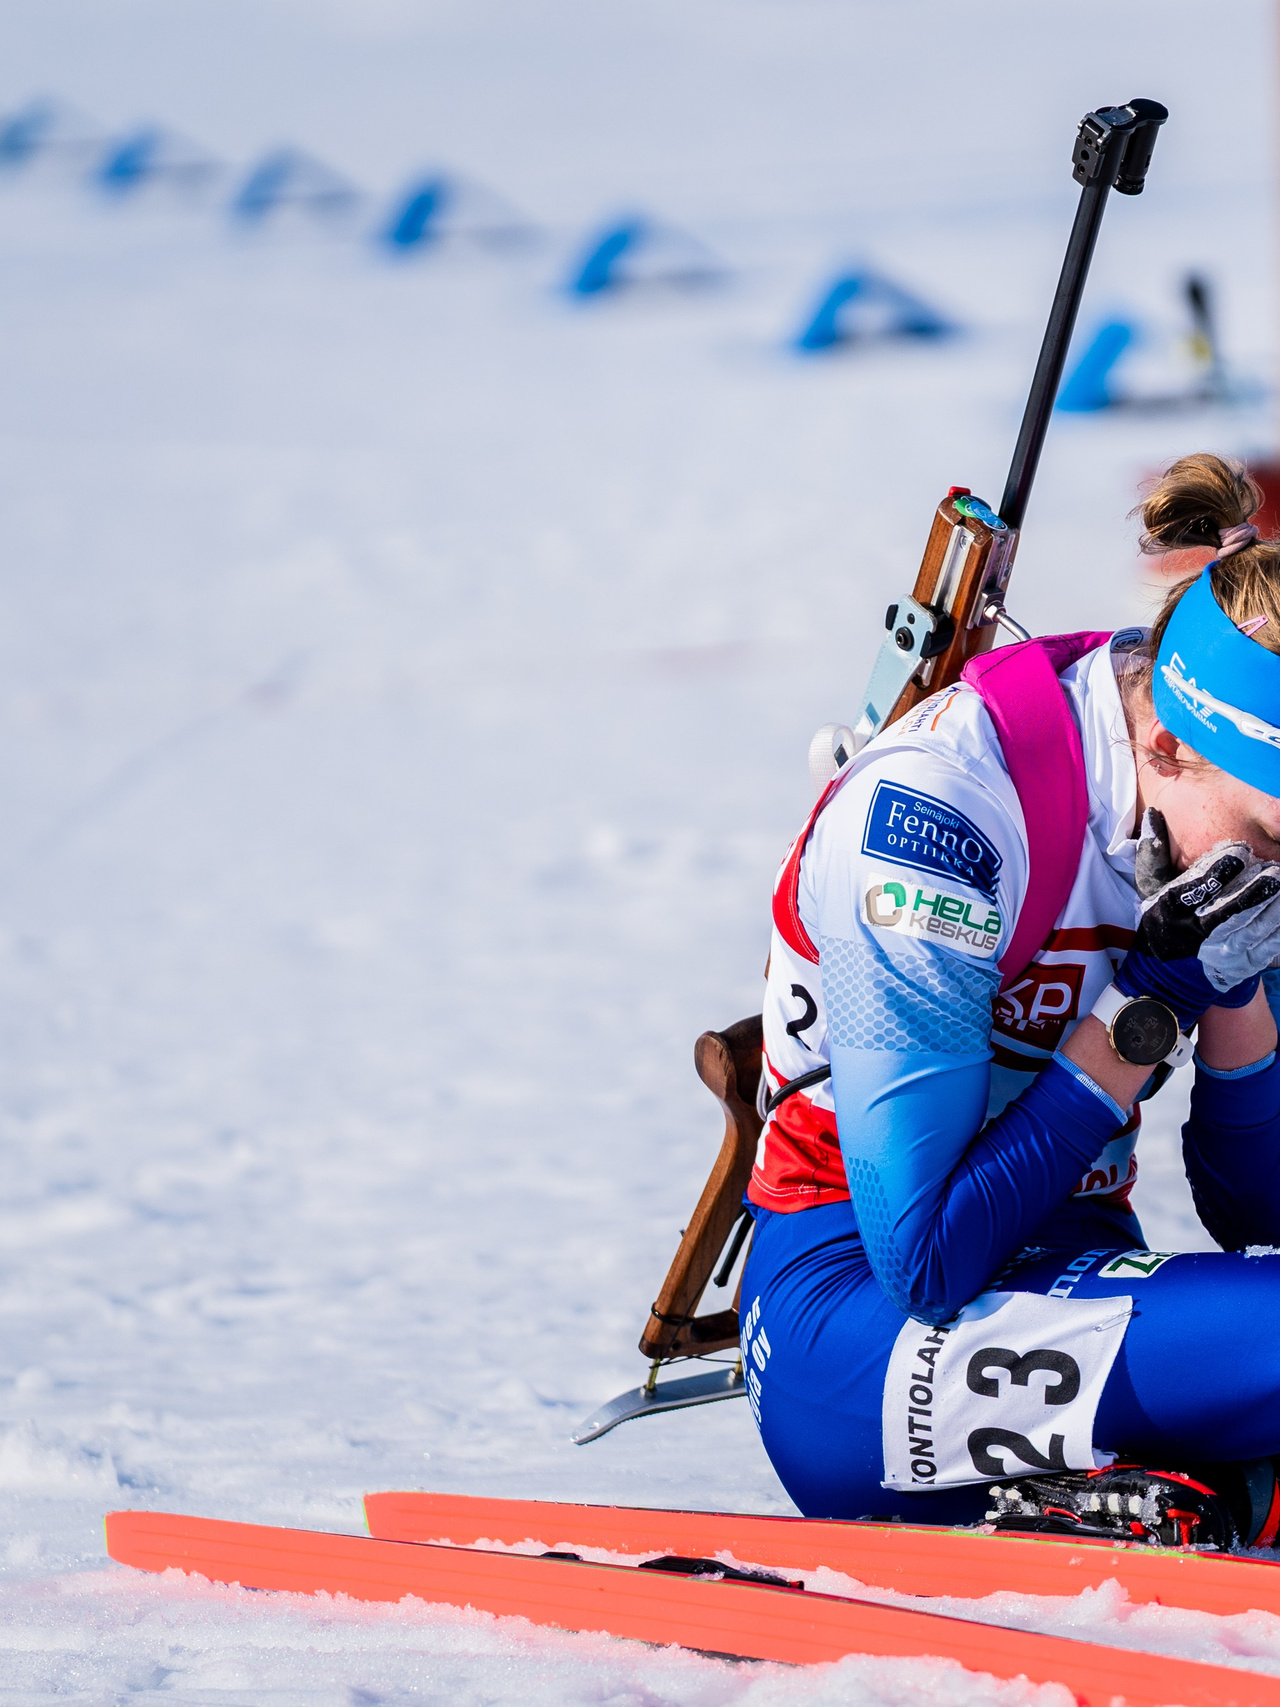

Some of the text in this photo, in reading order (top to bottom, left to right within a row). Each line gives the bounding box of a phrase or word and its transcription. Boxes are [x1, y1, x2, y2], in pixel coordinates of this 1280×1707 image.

[1190, 707, 1218, 734] ARMANI
[913, 801, 960, 830] Seinäjoki
[887, 833, 974, 877] OPTIIKKA
[751, 1325, 772, 1372] Oy
[908, 1325, 951, 1485] ONTIOLAH
[966, 1346, 1081, 1477] 23
